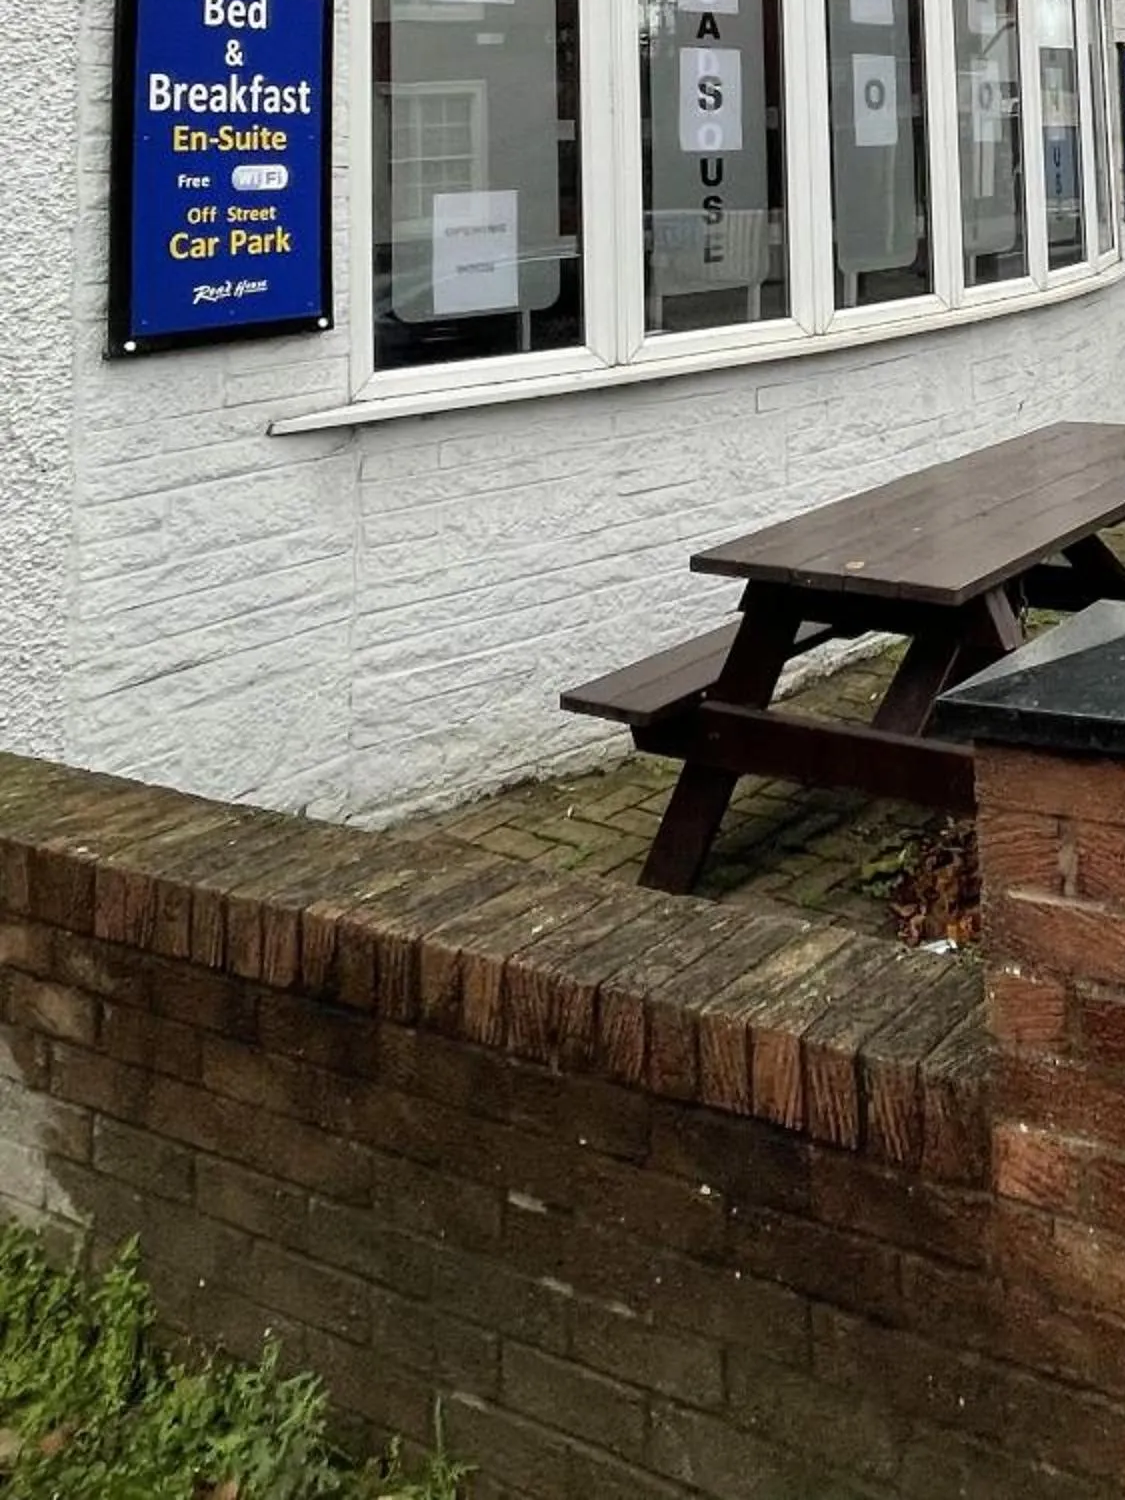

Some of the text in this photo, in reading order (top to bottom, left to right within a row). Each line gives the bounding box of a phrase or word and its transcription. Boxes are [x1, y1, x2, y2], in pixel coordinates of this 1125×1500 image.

[225, 39, 244, 67] &
[149, 73, 311, 115] Breakfast
[172, 125, 287, 152] En-Suite
[177, 174, 211, 189] Free
[187, 205, 277, 224] Off Street
[169, 226, 292, 260] Car Park
